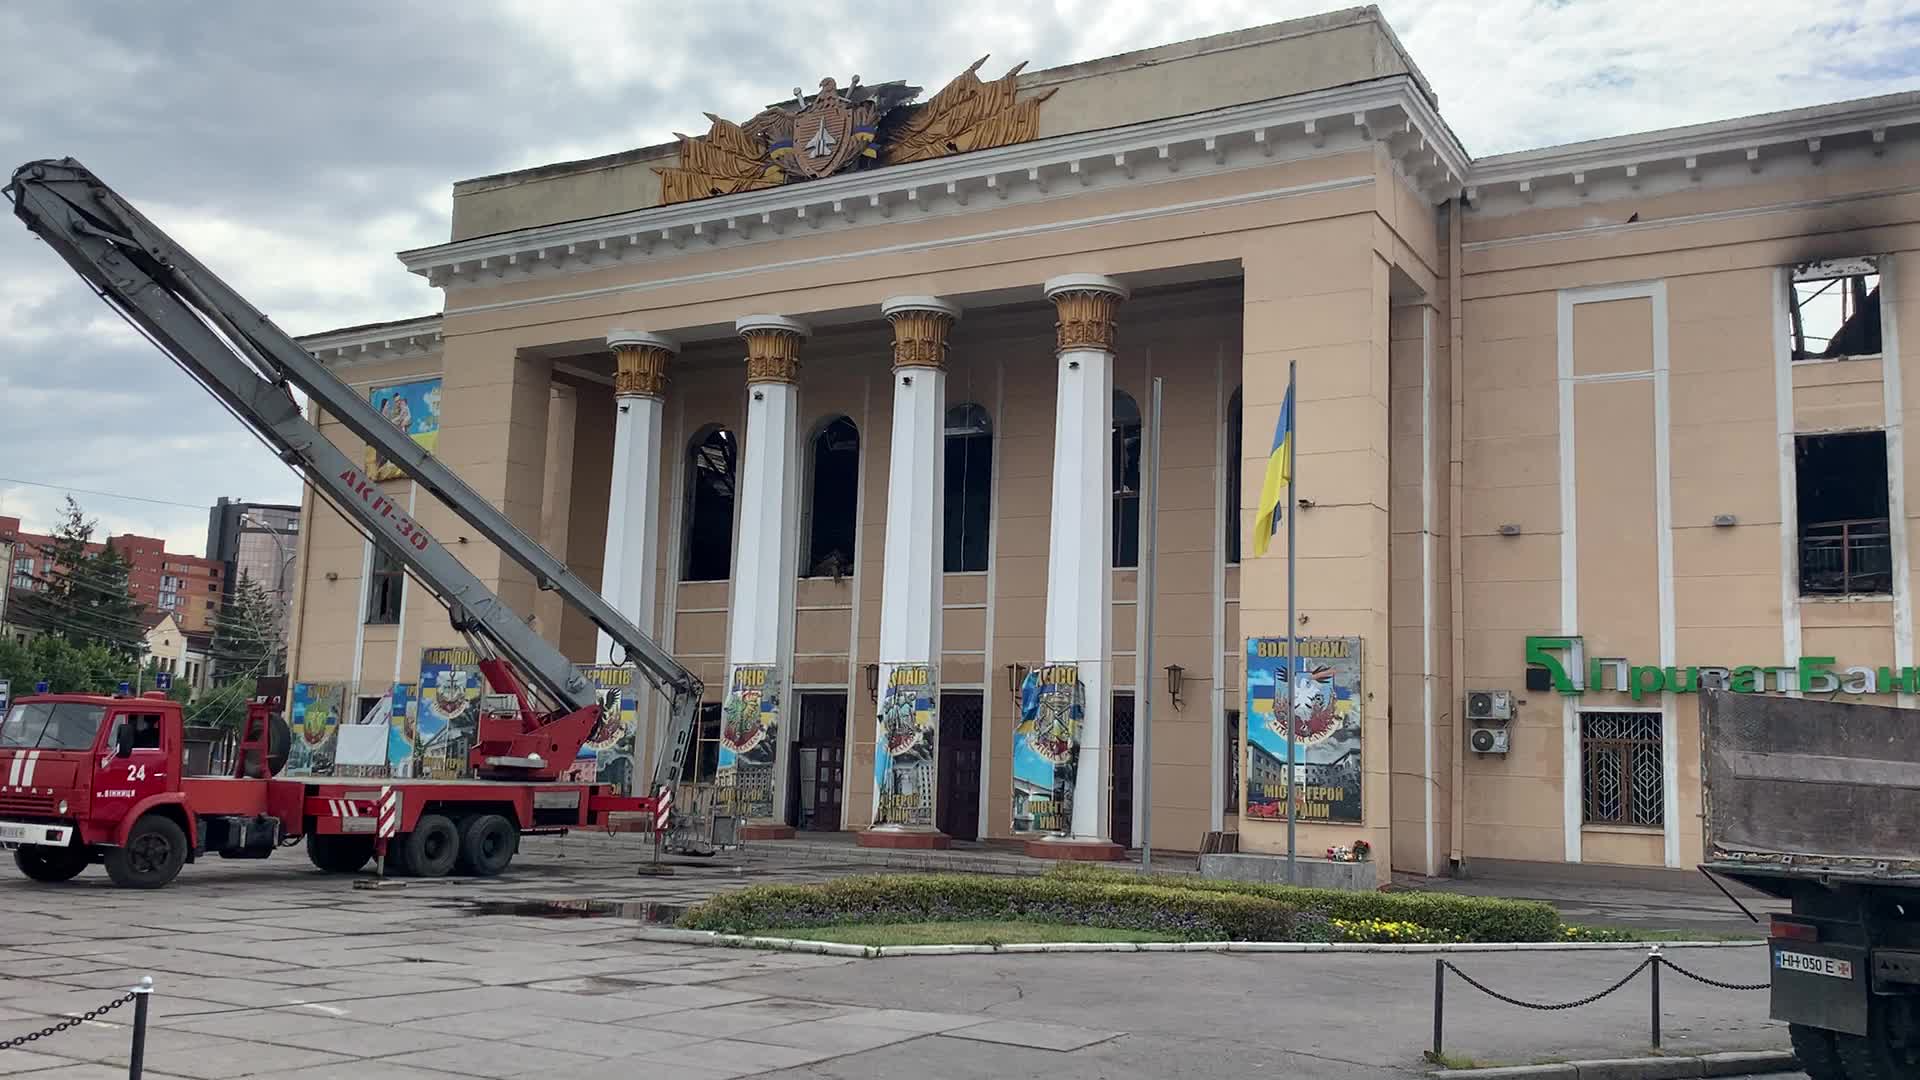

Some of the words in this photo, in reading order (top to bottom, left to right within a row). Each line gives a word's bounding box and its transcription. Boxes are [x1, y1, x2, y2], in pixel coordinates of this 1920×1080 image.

[338, 470, 429, 550] АКП-30
[1590, 655, 1920, 702] ПриватБан
[127, 764, 146, 781] 24
[1802, 957, 1822, 971] 050
